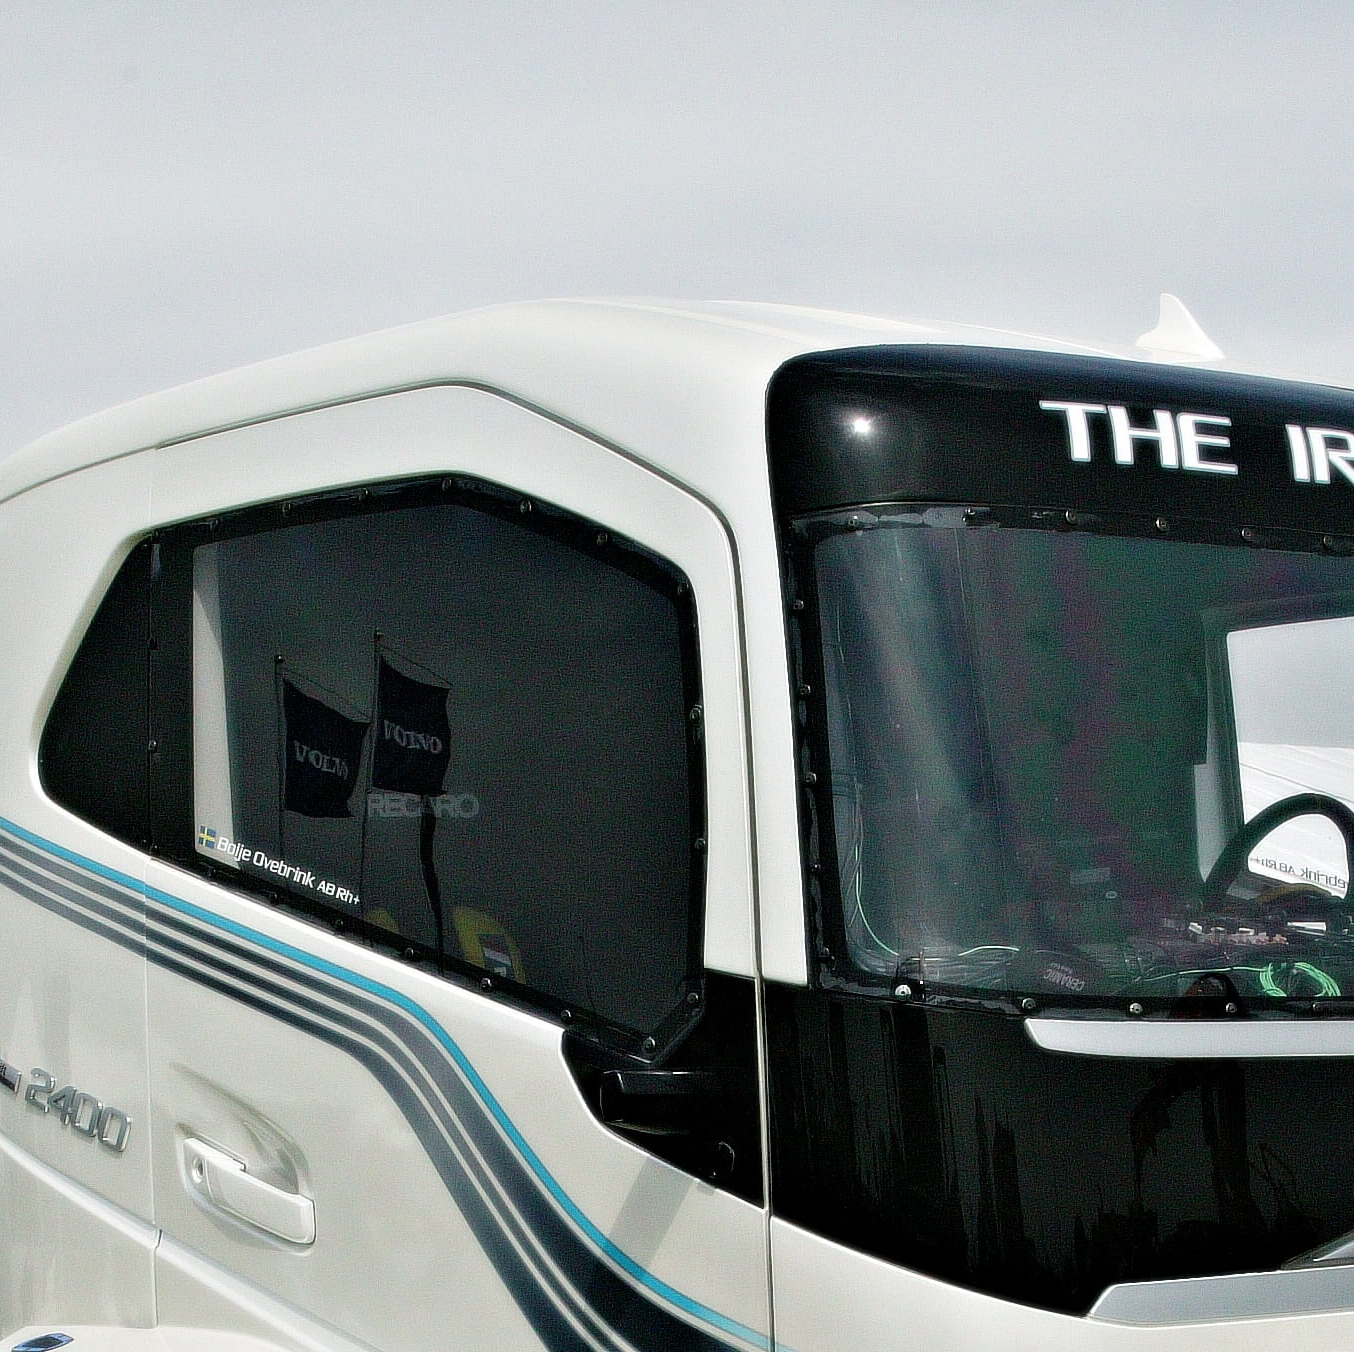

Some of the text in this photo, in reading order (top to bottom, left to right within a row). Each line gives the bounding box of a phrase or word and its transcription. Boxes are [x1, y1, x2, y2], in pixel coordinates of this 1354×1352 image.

[1040, 400, 1238, 476] THE
[253, 851, 316, 888] Ovebrink
[317, 880, 336, 895] AB
[25, 1067, 133, 1152] 2400
